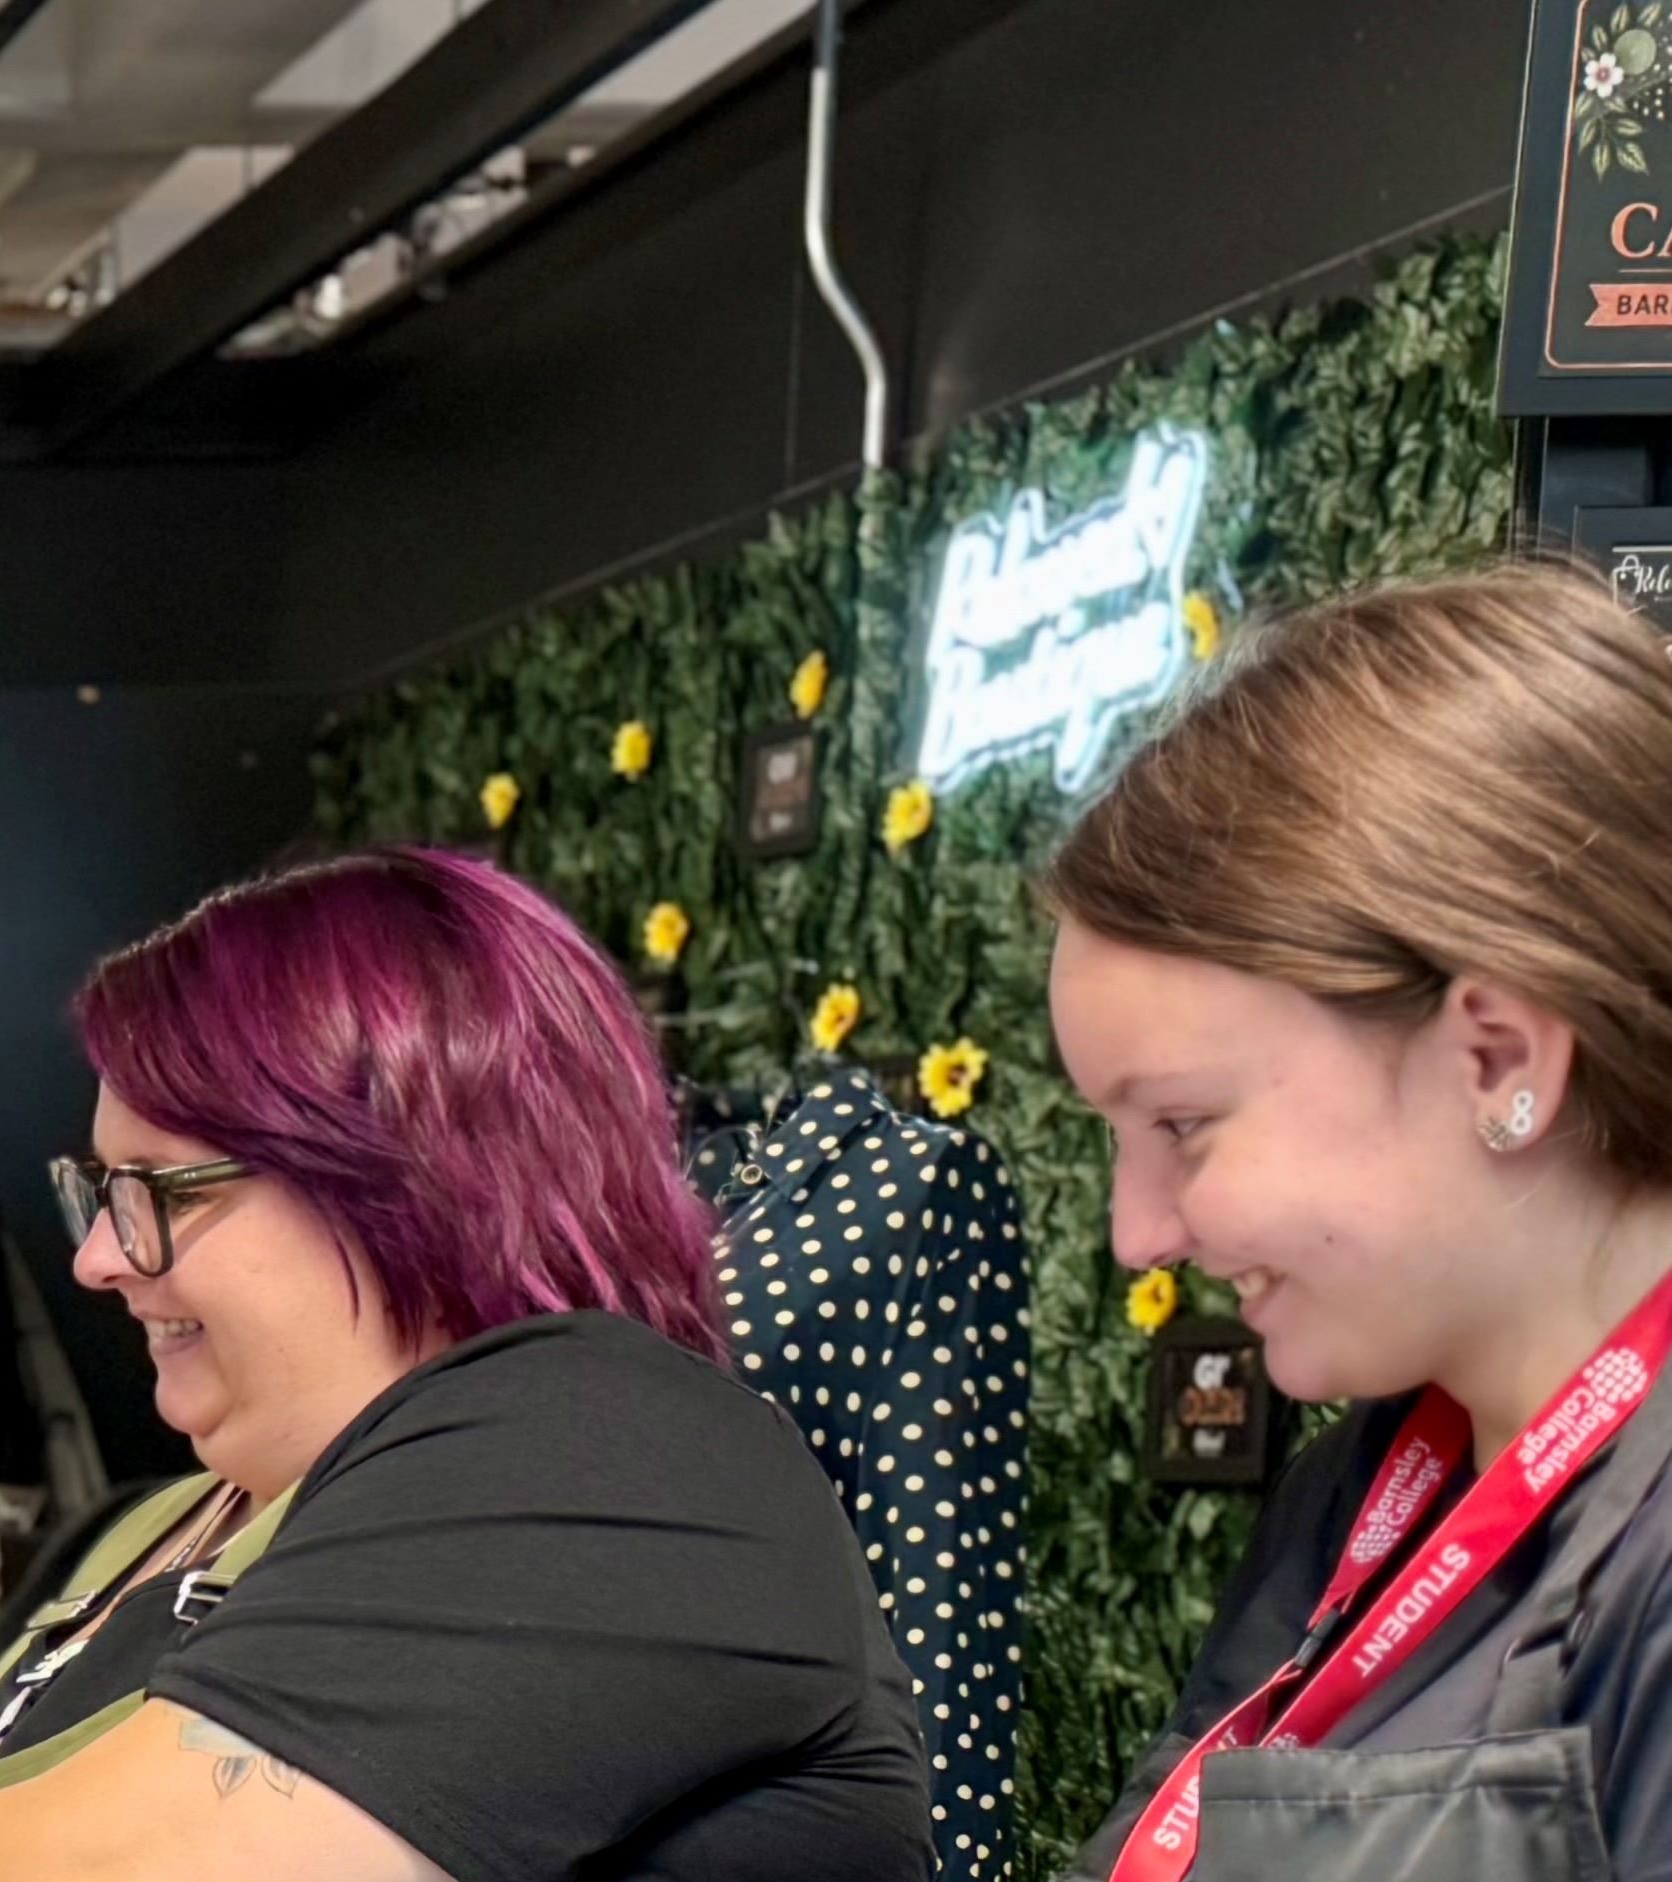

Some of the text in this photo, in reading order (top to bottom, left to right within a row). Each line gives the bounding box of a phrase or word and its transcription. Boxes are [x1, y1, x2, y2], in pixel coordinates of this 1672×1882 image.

[1611, 202, 1672, 258] C
[1617, 294, 1672, 315] BAR
[1516, 1386, 1595, 1465] College
[1523, 1400, 1617, 1493] Barnsley
[1366, 1436, 1431, 1524] Barnsley
[1386, 1457, 1443, 1526] College
[1351, 1543, 1471, 1678] STUDENT
